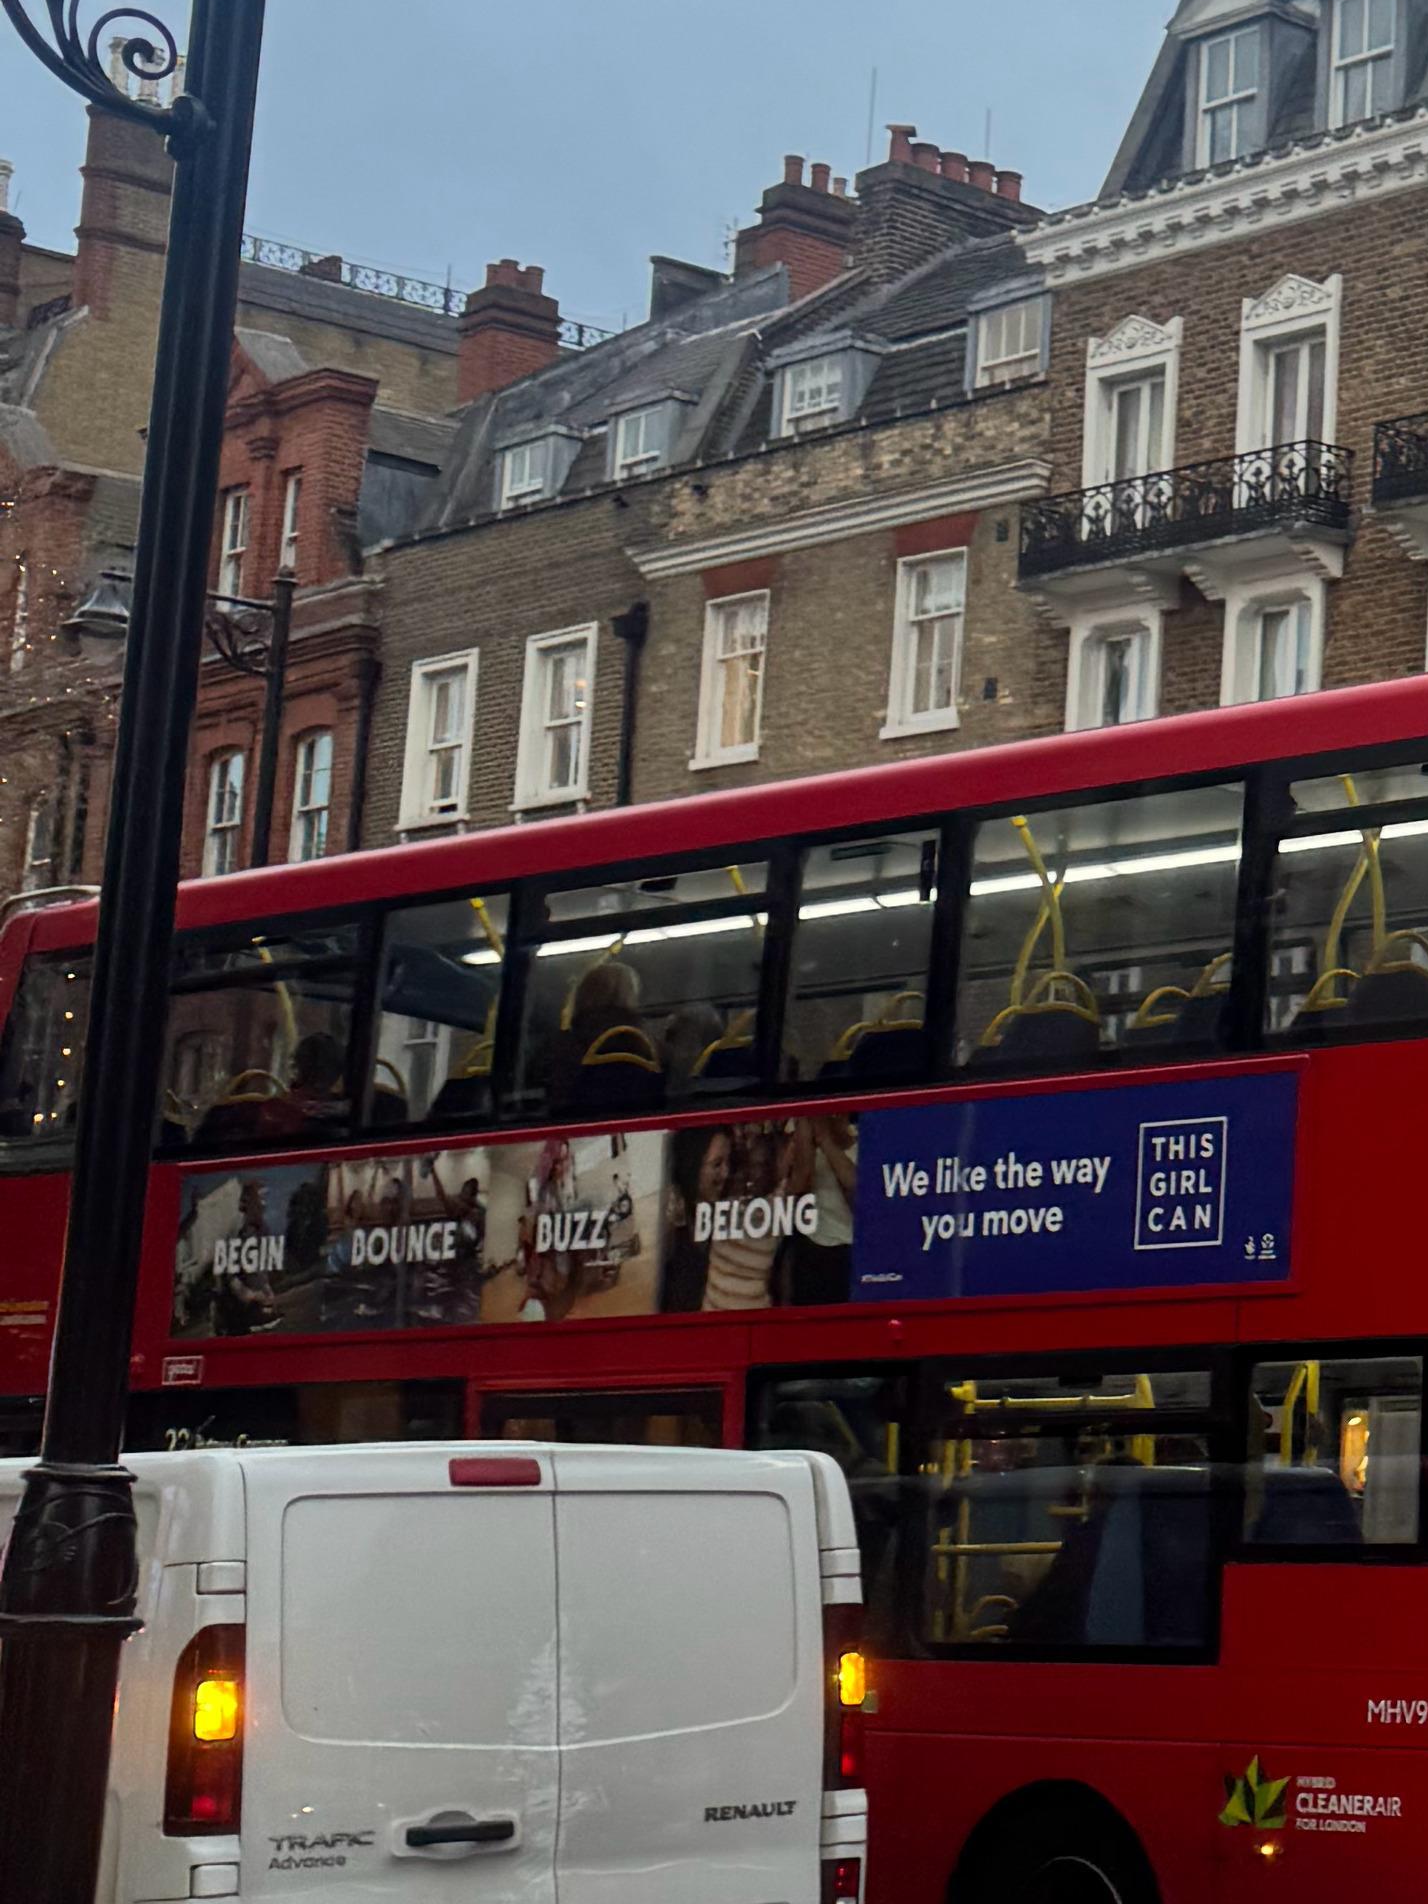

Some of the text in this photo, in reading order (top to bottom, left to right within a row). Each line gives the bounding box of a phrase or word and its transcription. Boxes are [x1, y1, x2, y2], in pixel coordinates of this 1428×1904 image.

[1151, 1133, 1214, 1161] THIS
[882, 1152, 1111, 1197] We like the way
[1149, 1169, 1212, 1196] GIRL
[694, 1193, 818, 1242] BELONG
[921, 1206, 1064, 1251] you move
[1148, 1204, 1212, 1232] CAN
[351, 1222, 457, 1266] BOUNCE
[536, 1211, 609, 1253] BUZZ
[213, 1235, 285, 1275] BEGIN
[704, 1800, 797, 1822] RENAULT
[1296, 1818, 1366, 1833] FOR LONDON
[268, 1831, 376, 1851] TRAFIC
[268, 1855, 346, 1870] Advance
